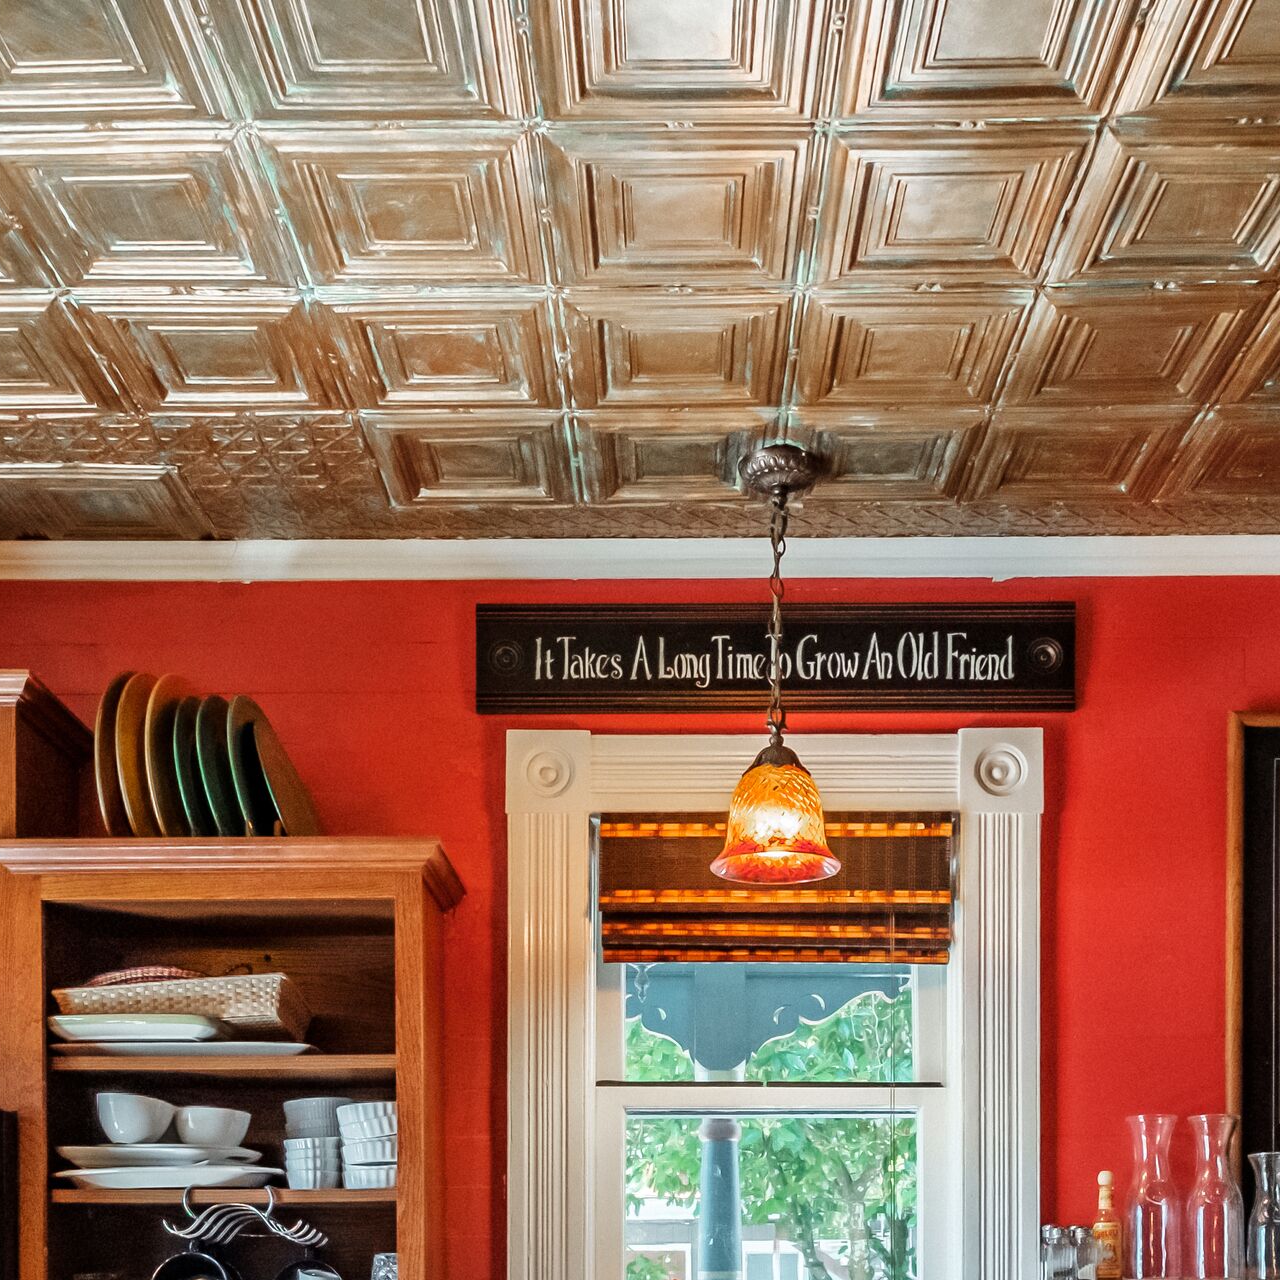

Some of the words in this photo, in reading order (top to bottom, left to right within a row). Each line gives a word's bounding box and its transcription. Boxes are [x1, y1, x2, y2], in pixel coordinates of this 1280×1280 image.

[534, 637, 554, 680] It
[556, 636, 623, 681] Takes
[630, 635, 652, 680] A
[658, 636, 710, 688] Long
[711, 635, 766, 681] Time
[796, 634, 860, 681] Grow
[862, 631, 893, 680] An
[897, 631, 939, 681] Old
[945, 632, 1014, 681] Friend
